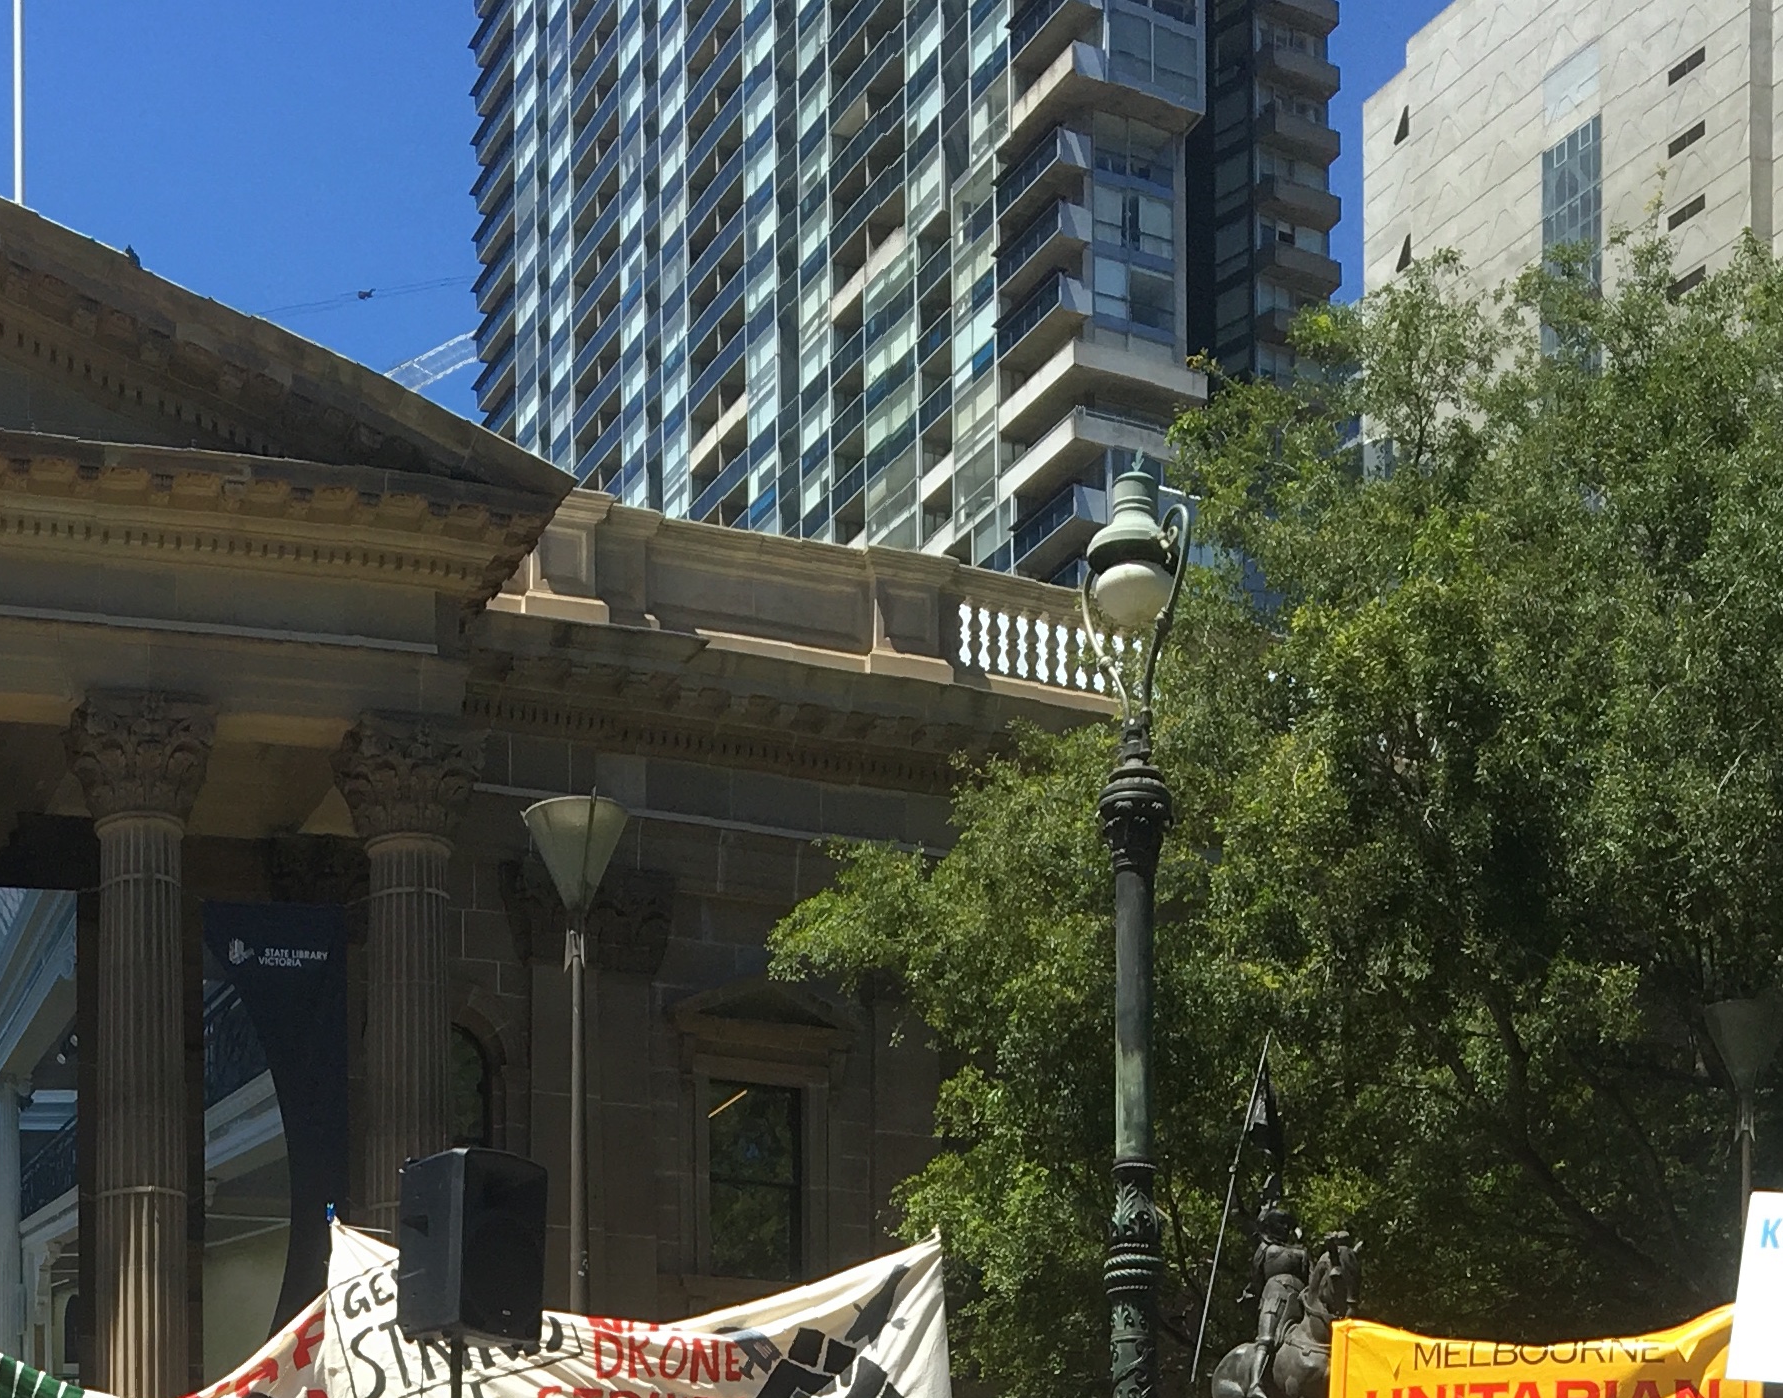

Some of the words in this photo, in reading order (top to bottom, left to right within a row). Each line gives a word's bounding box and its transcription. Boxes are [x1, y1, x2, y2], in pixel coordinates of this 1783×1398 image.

[258, 956, 302, 968] VICTORIA
[264, 948, 289, 958] STATE
[291, 949, 329, 961] LIBRARY
[342, 1268, 399, 1320] GE
[1413, 1338, 1668, 1371] MELBOURNE
